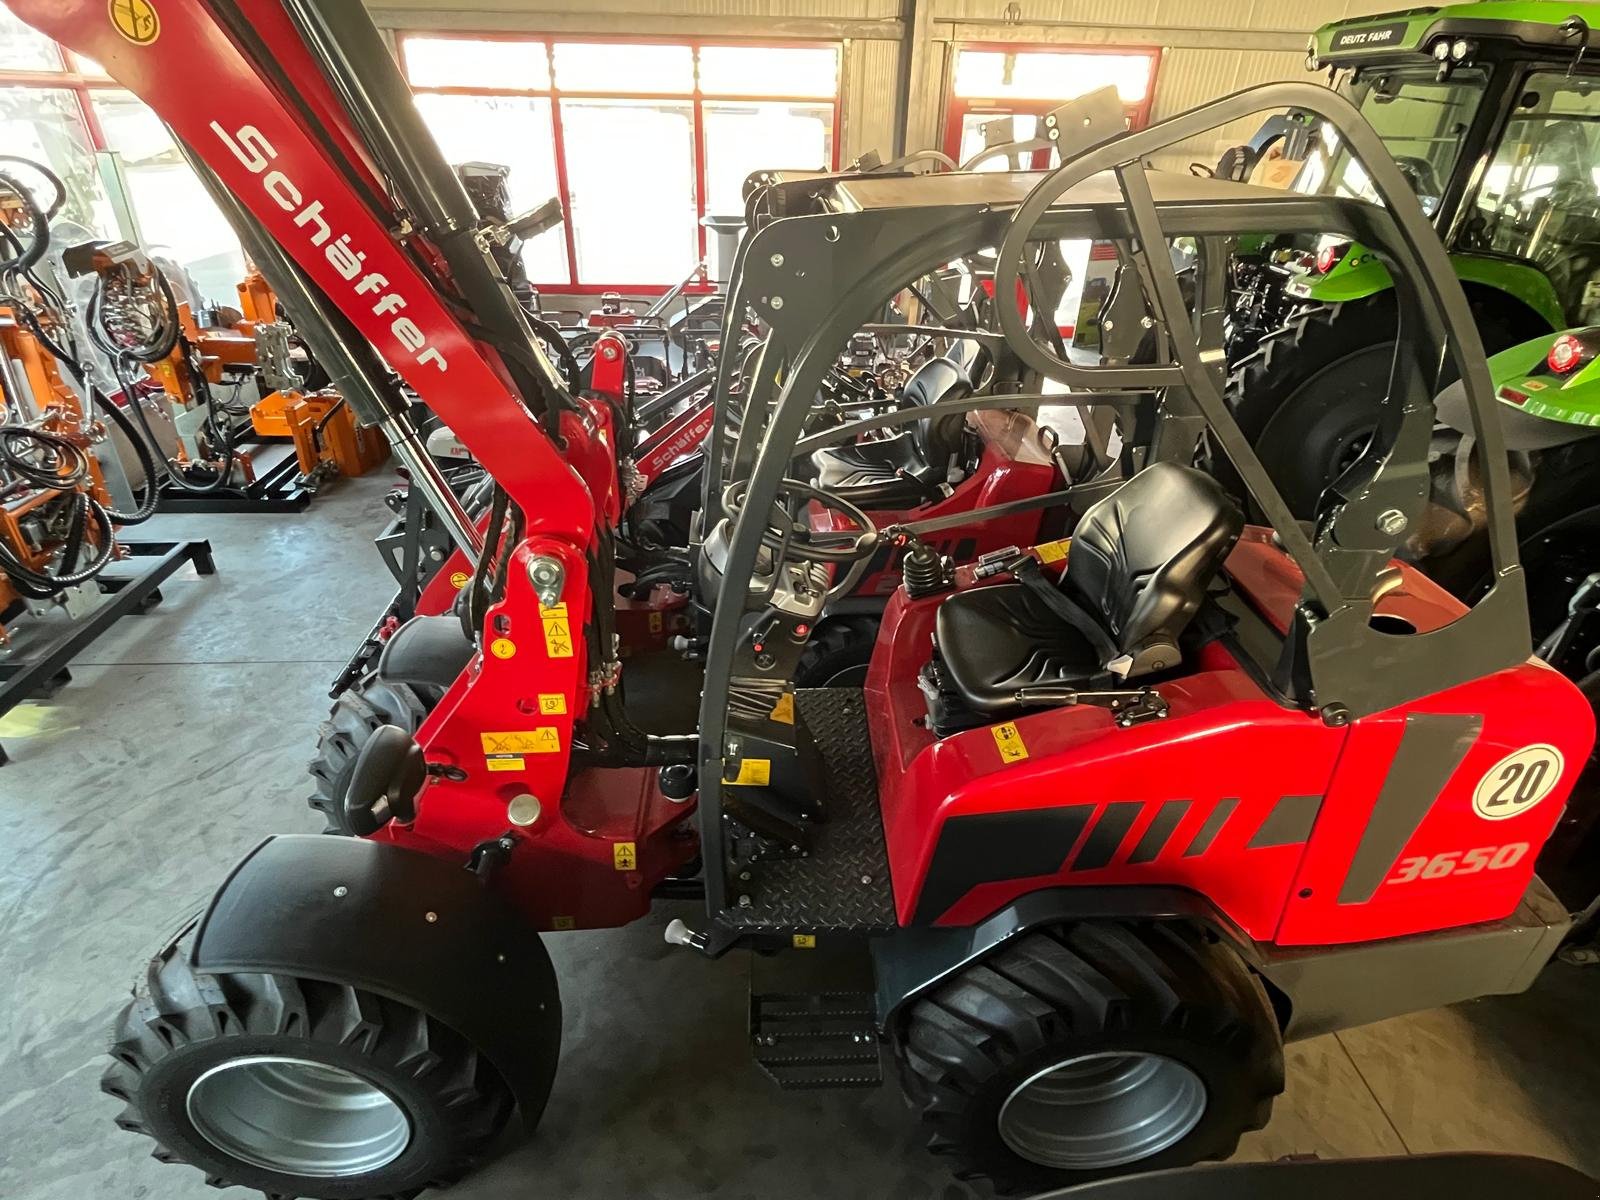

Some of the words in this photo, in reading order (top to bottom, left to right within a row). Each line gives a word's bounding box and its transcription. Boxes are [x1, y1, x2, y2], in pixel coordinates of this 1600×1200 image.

[1340, 33, 1366, 45] DEUTZ
[1368, 30, 1392, 42] FAHR
[210, 120, 448, 373] Schäffer
[652, 418, 711, 471] Schäffer
[1487, 760, 1549, 807] 20
[1386, 843, 1530, 884] 3650
